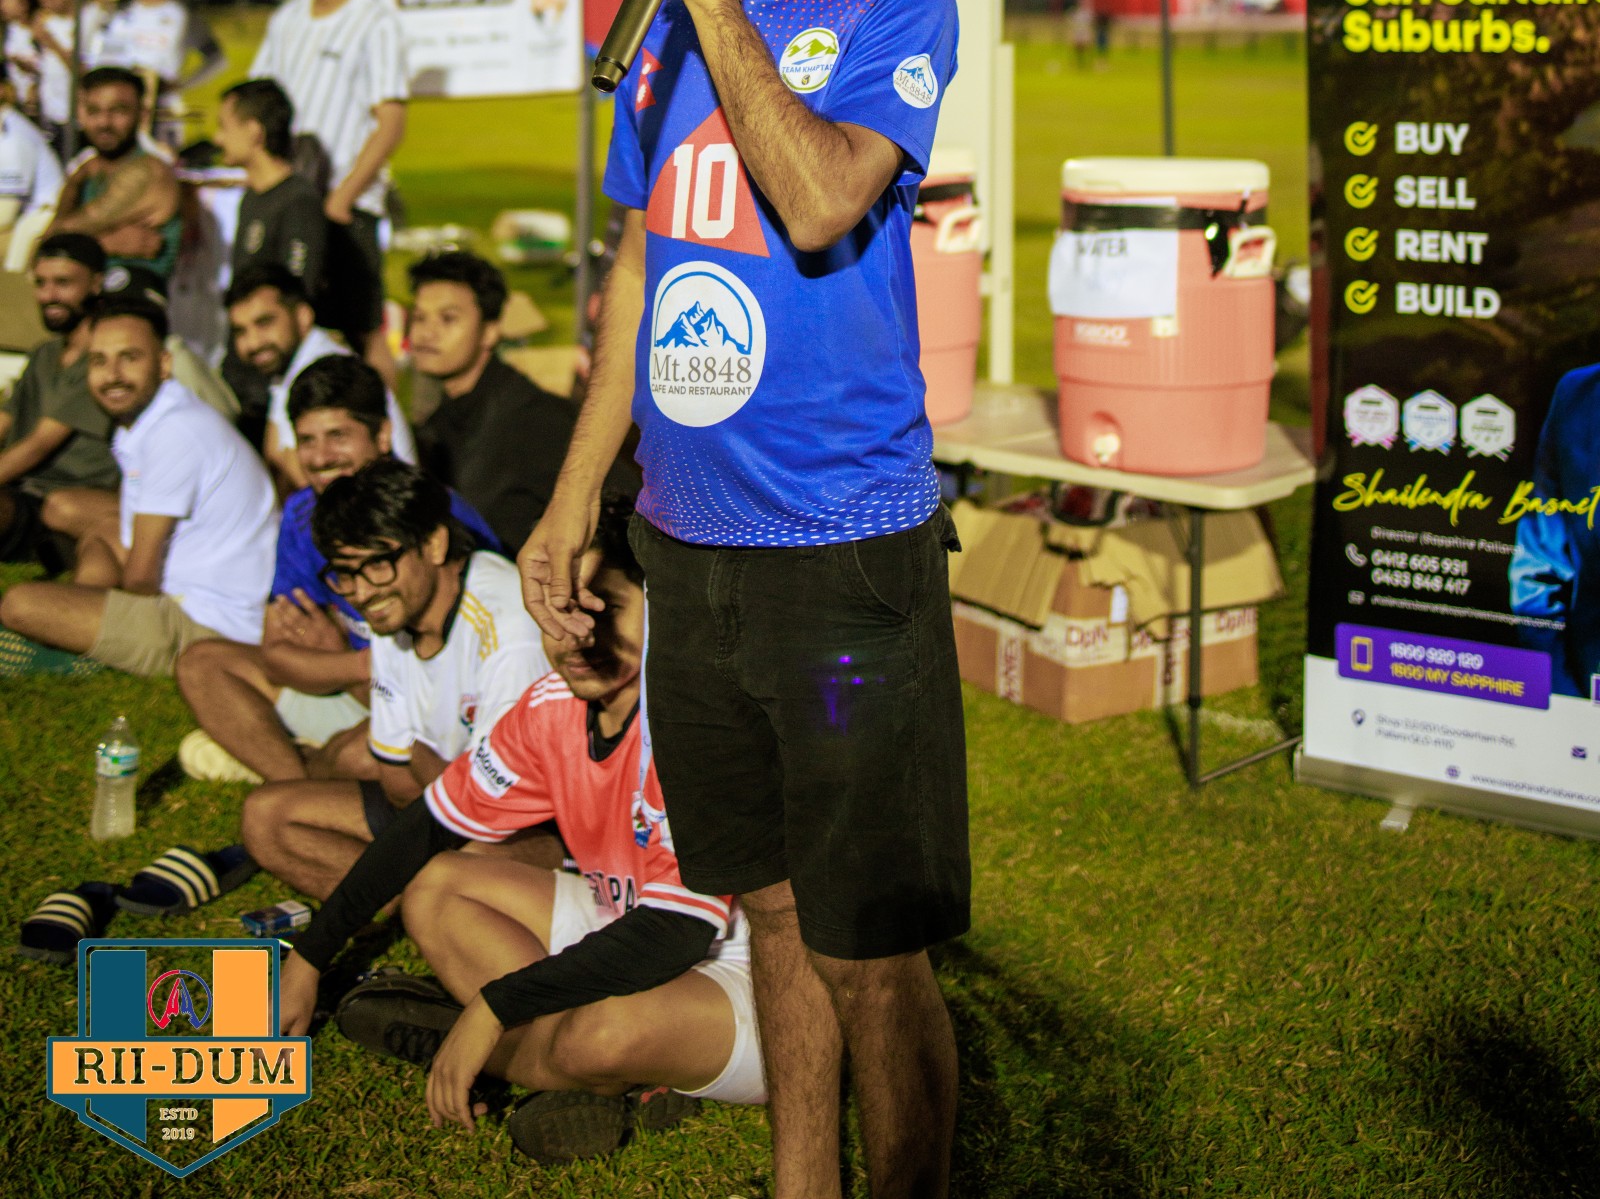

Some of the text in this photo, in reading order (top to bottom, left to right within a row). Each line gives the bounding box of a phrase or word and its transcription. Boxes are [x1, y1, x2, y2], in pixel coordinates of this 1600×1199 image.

[1343, 8, 1550, 54] Suburbs.
[782, 66, 801, 74] TEAM
[1395, 121, 1470, 155] BUY
[672, 143, 739, 239] 10
[1394, 175, 1477, 210] SELL
[1395, 228, 1489, 265] RENT
[1395, 282, 1501, 319] BUILD
[652, 353, 752, 383] Mt.8848
[652, 384, 752, 396] CAFE AND RESTAURANT
[1332, 468, 1493, 527] Shailendra
[1425, 667, 1450, 684] MY
[1451, 670, 1525, 697] SAPPHIRE
